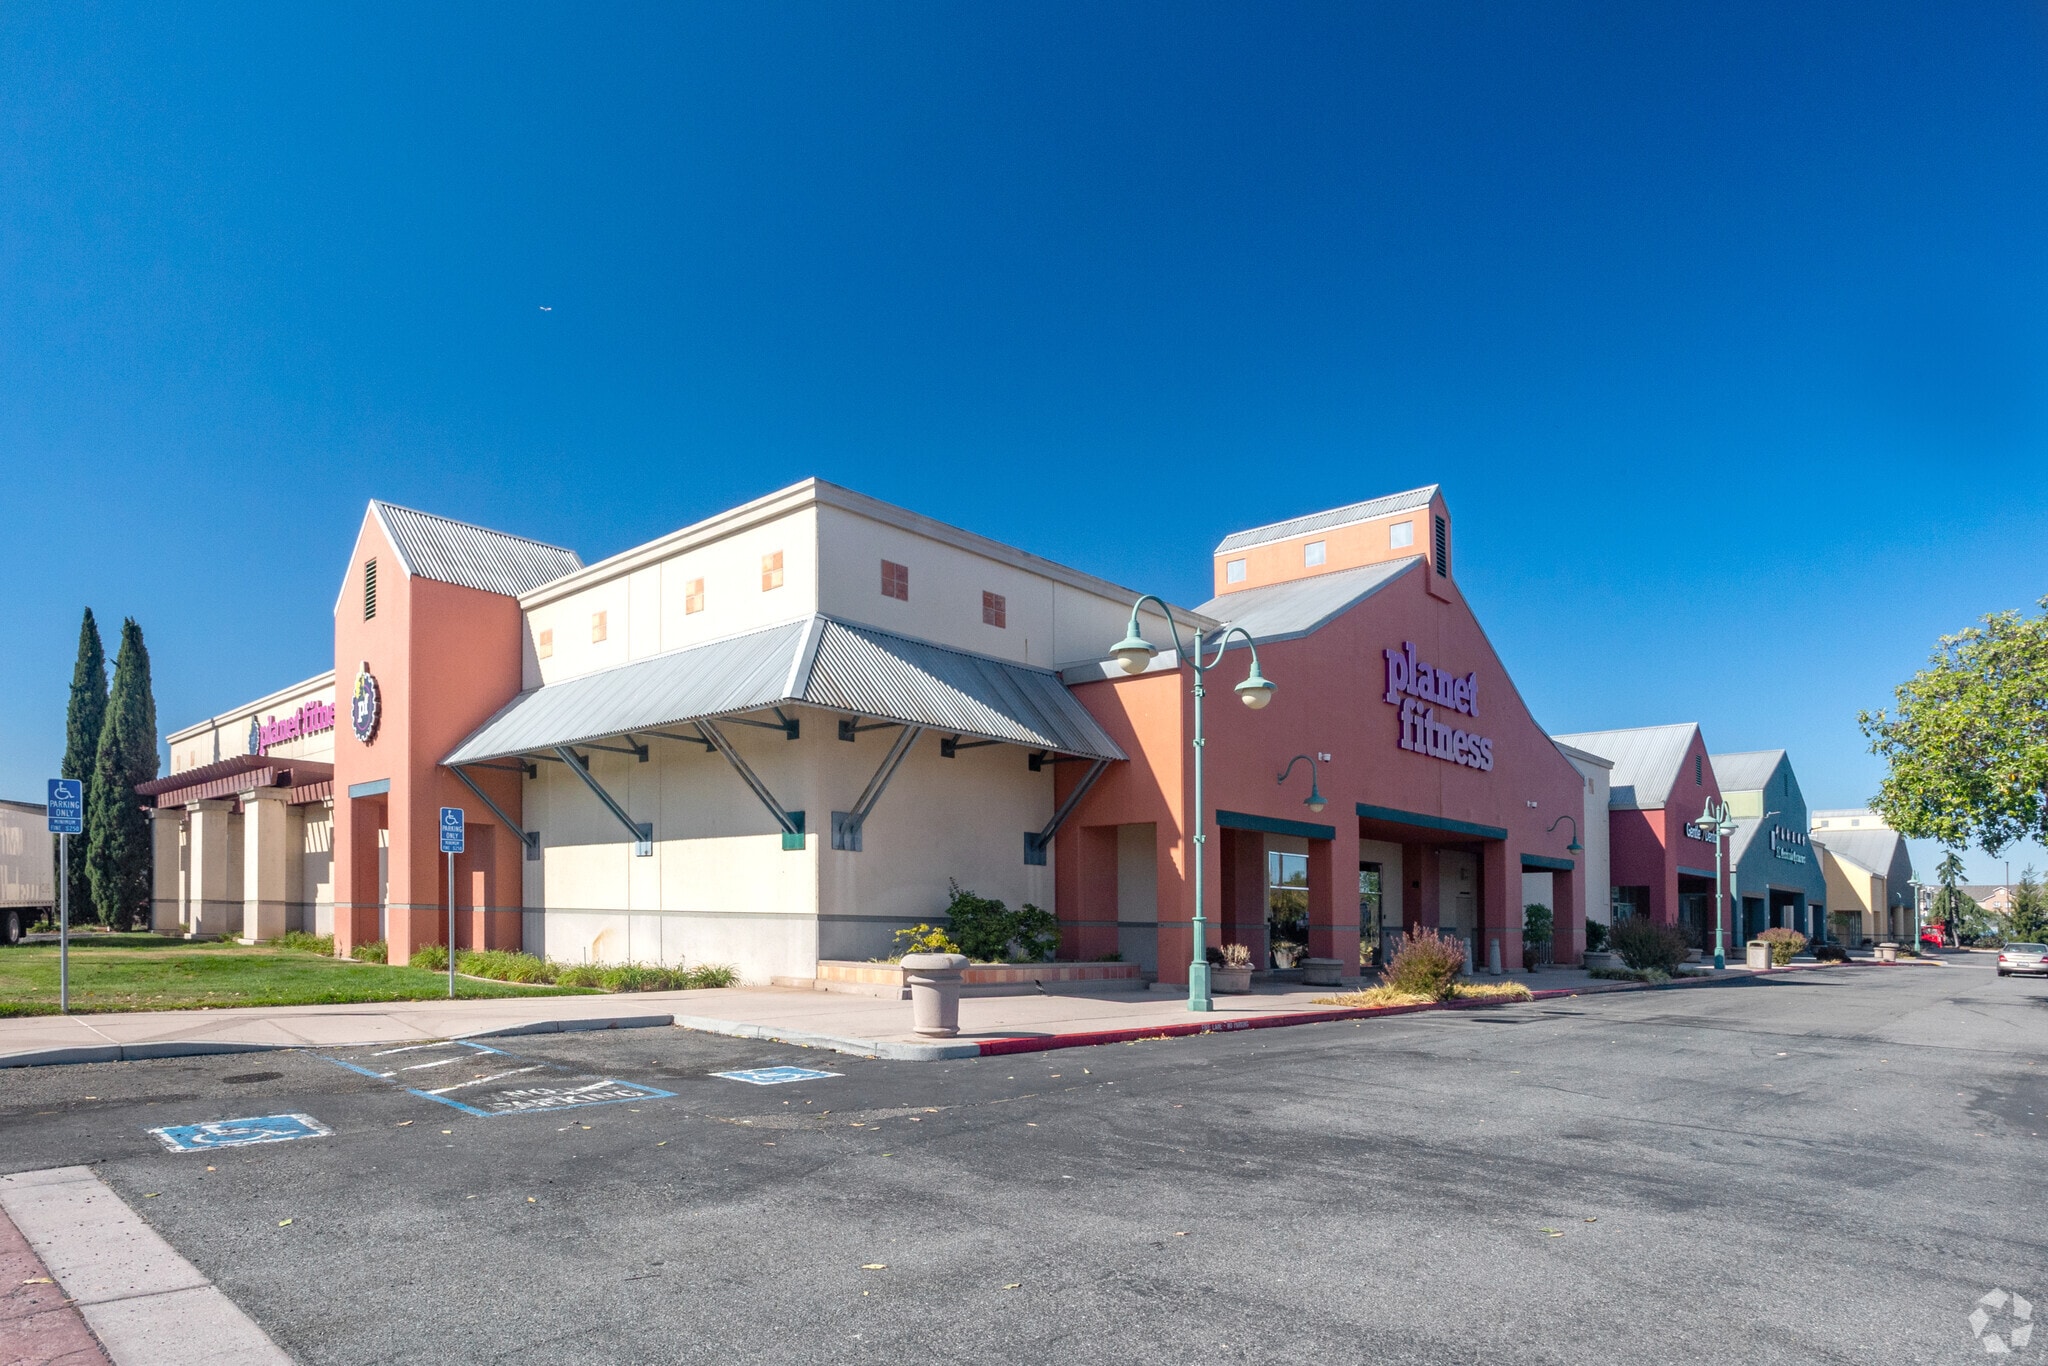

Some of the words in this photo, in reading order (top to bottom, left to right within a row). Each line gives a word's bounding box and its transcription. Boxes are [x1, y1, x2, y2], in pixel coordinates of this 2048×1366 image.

[1384, 641, 1479, 717] planet
[358, 693, 369, 723] pf
[259, 708, 302, 756] planet
[302, 701, 334, 733] fitne
[1398, 699, 1493, 771] fitness
[50, 800, 79, 809] PARKING
[56, 809, 74, 817] ONLY
[488, 1089, 644, 1109] PARKING
[503, 1088, 556, 1097] NO
